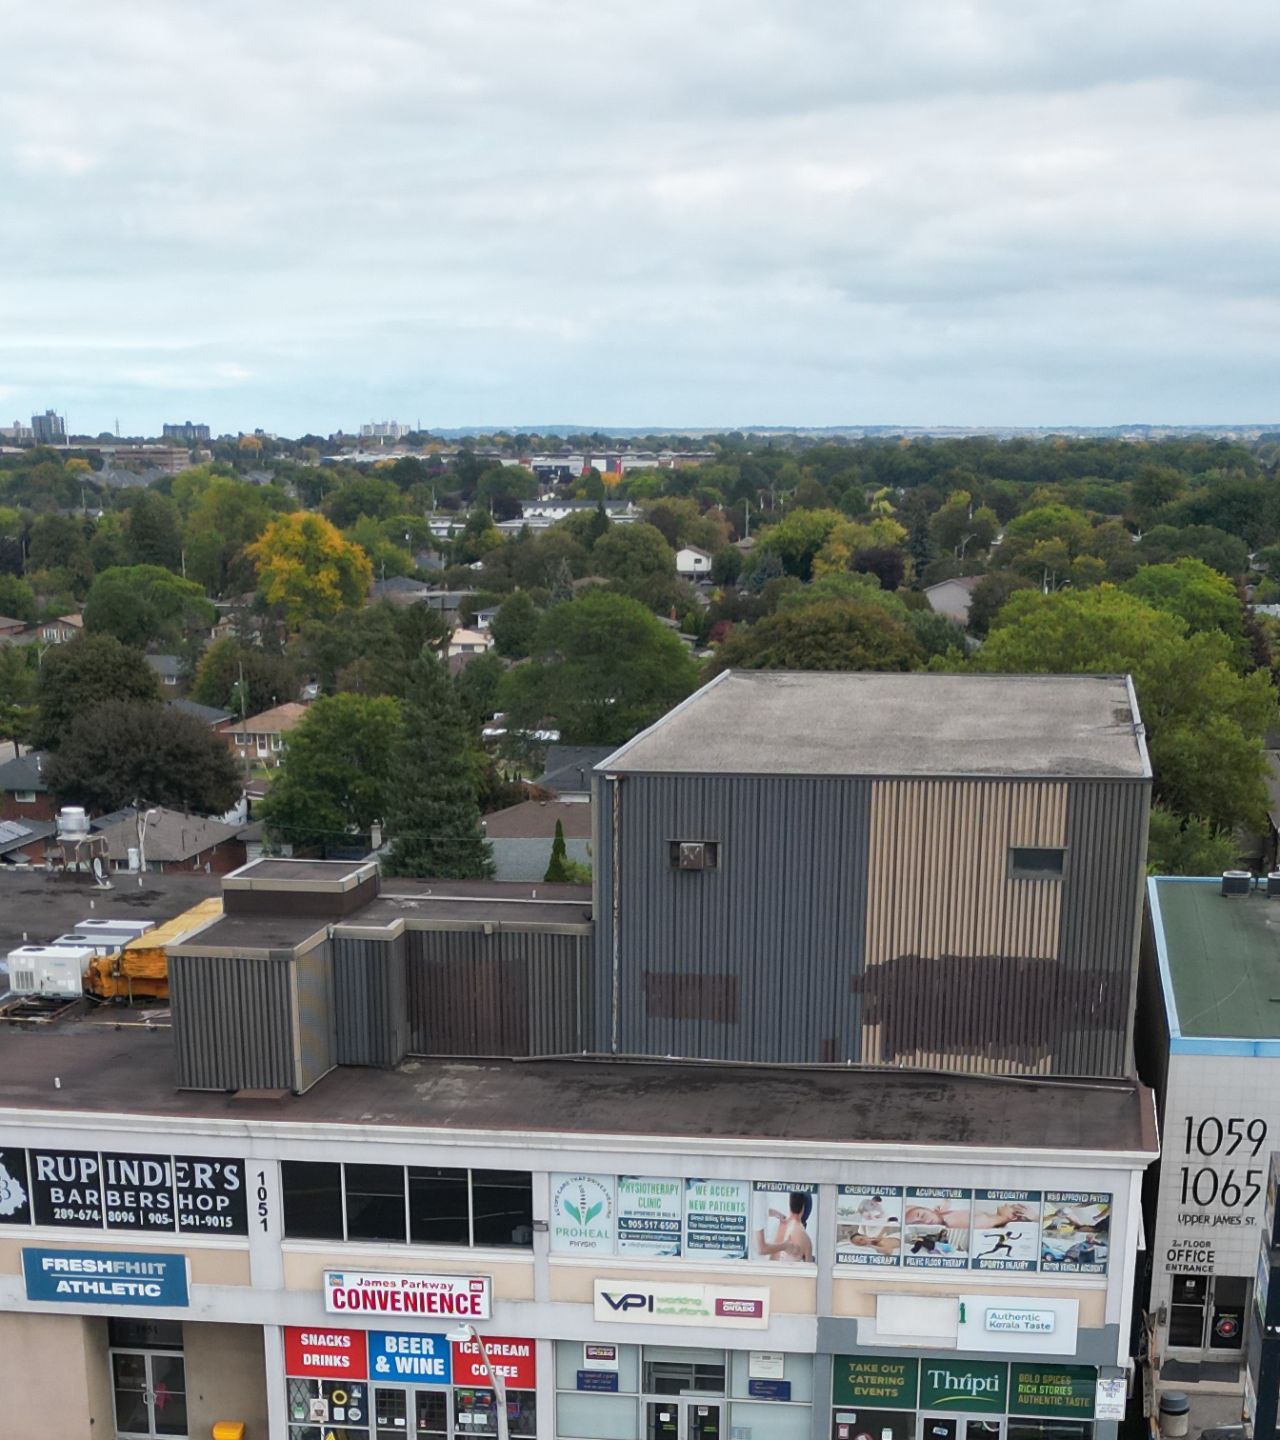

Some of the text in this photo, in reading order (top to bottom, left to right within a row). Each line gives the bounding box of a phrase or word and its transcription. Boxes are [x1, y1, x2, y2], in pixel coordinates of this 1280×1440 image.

[1184, 1116, 1268, 1157] 1059
[36, 1155, 240, 1191] RUPINDER'S
[620, 1183, 680, 1197] PHYSIOTHERAPY
[695, 1185, 740, 1199] WE ACCEPT
[756, 1182, 815, 1193] PHYSIOTHERAPY
[844, 1185, 897, 1196] CHIROPRACTIC
[915, 1188, 963, 1198] ACUPUNCTURE
[1180, 1166, 1264, 1207] 1065
[50, 1187, 230, 1212] BARBERSHOP
[256, 1171, 269, 1232] 1051
[637, 1197, 662, 1210] CLINIC
[688, 1199, 746, 1213] NEW PATIENTS
[1178, 1214, 1257, 1227] UPPER JAMES ST.
[556, 1227, 610, 1240] PROHEAL
[838, 1254, 898, 1266] MASSAGE THERAPY
[925, 1257, 941, 1267] FLOOR
[942, 1258, 966, 1268] THERAPY
[1166, 1249, 1215, 1264] OFFICE
[42, 1257, 167, 1276] FRESHFHIIT
[980, 1259, 1029, 1270] SPORTS INJURY
[1165, 1264, 1214, 1273] ENTRANCE
[56, 1280, 161, 1297] ATHLETIC
[356, 1278, 454, 1292] James Parkway
[332, 1288, 483, 1315] CONVENIENCE
[601, 1292, 654, 1313] VPI
[989, 1312, 1041, 1322] Authentic
[1024, 1322, 1052, 1331] Taste
[300, 1334, 352, 1347] SNACKS
[385, 1336, 435, 1355] BEER
[459, 1341, 530, 1357] ICE CREAM
[303, 1354, 350, 1367] DRINKS
[375, 1356, 446, 1376] & WINE
[848, 1362, 906, 1374] TAKE OUT
[848, 1375, 905, 1387] CATERING
[927, 1369, 1000, 1396] Thripti
[1019, 1374, 1072, 1386] BOLD SPICES
[854, 1387, 899, 1398] EVENTS
[1018, 1384, 1073, 1396] RICH STORIES
[1018, 1394, 1091, 1408] AUTHENTIC TASTE
